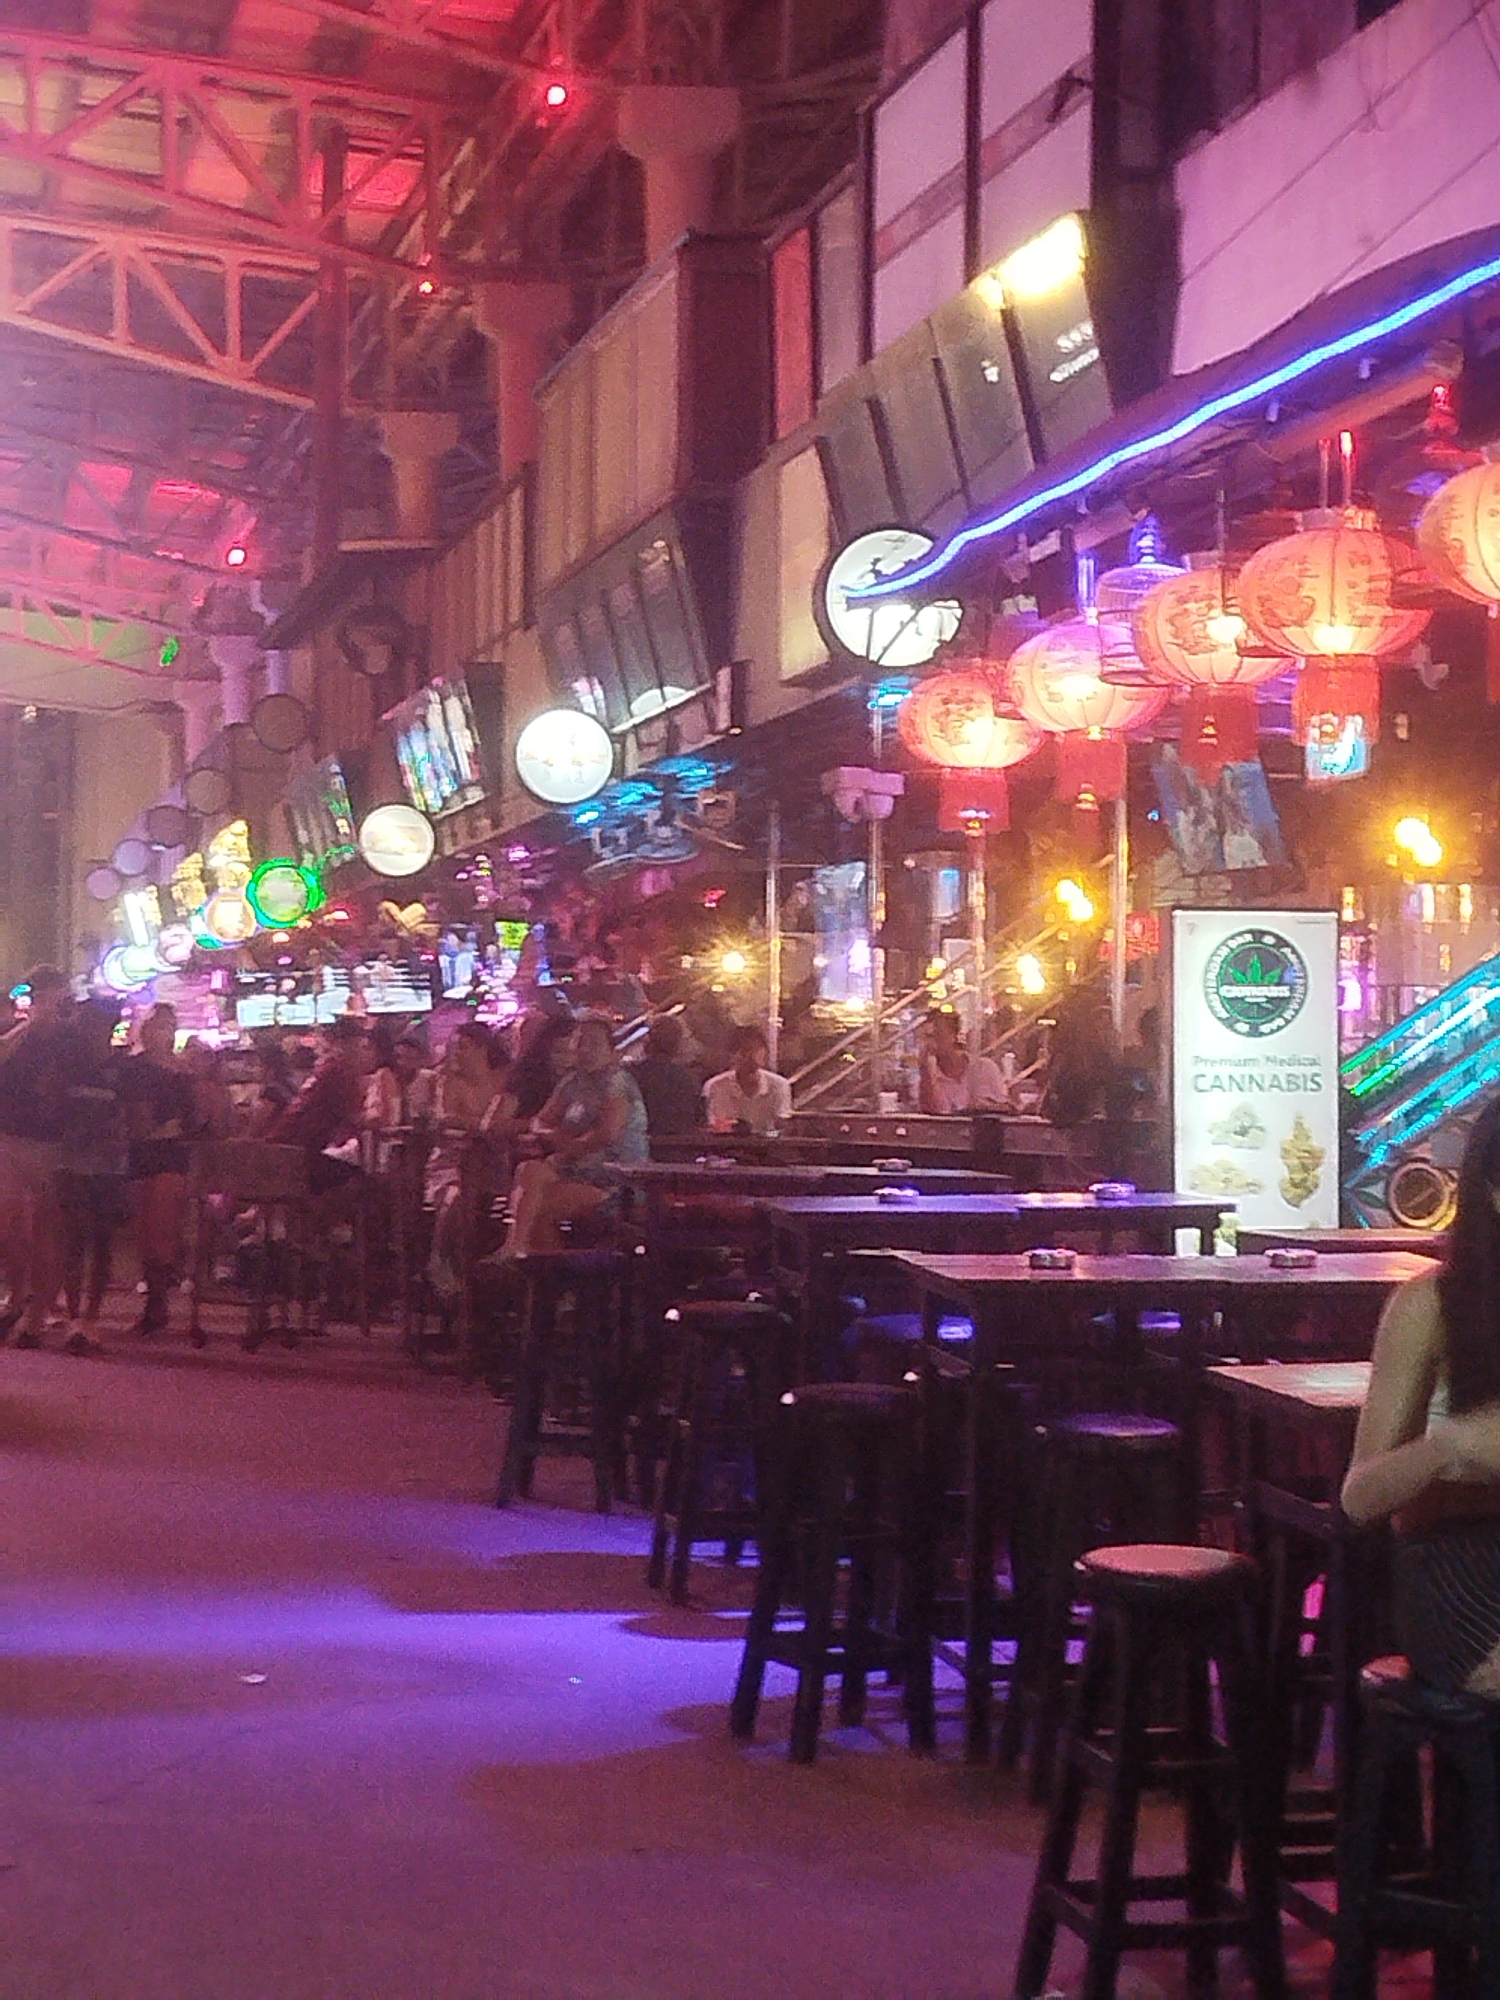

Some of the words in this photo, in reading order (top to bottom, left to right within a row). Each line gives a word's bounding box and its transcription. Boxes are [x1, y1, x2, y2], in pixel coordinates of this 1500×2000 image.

[1192, 1055, 1259, 1067] Premium
[1265, 1054, 1322, 1067] Medical
[1193, 1073, 1323, 1092] CANNABIS
